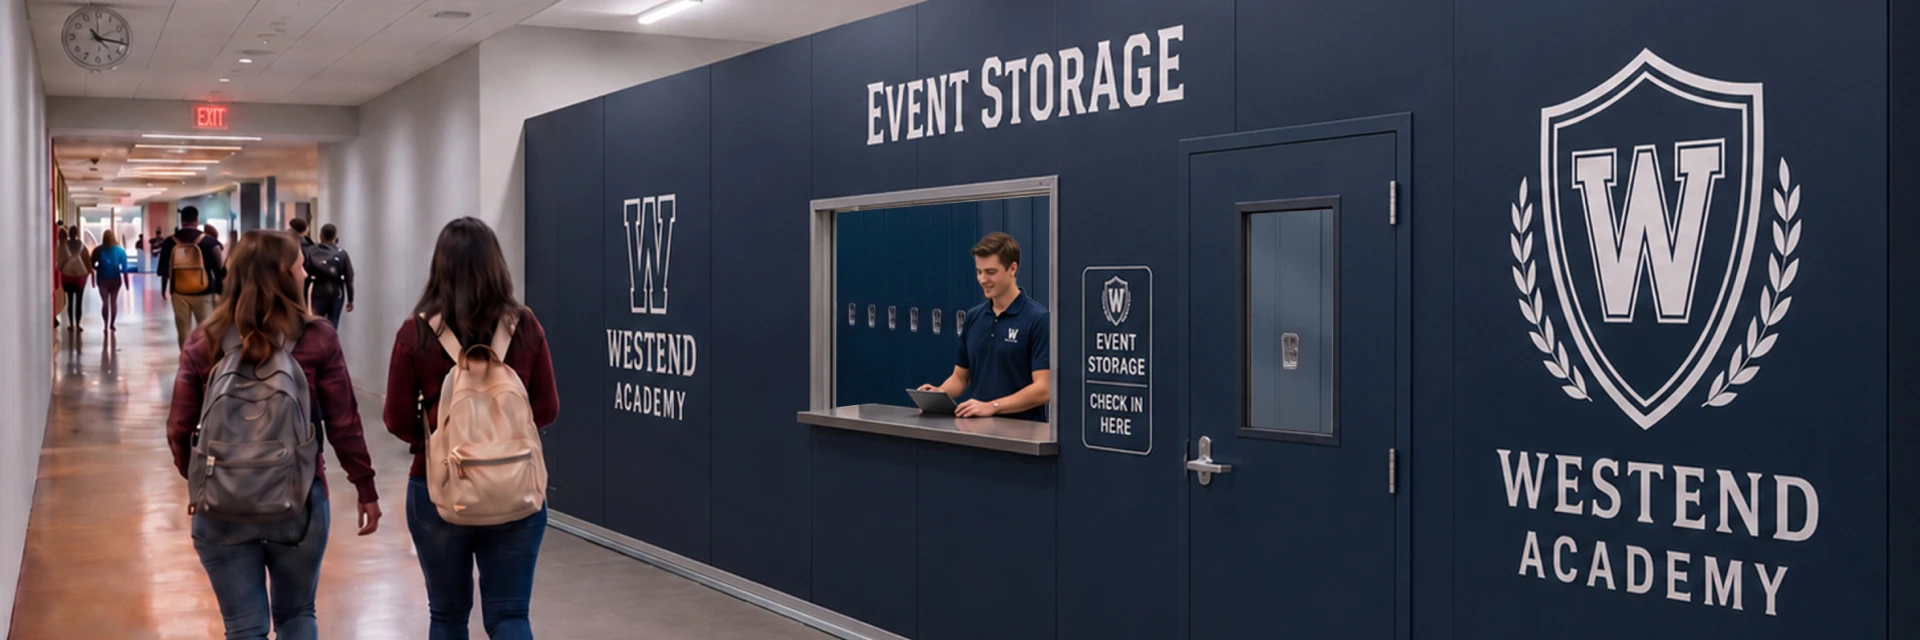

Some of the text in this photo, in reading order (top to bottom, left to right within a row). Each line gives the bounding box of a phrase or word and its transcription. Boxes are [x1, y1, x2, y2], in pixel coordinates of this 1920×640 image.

[866, 24, 1186, 146] EVENT STORAGE
[197, 107, 227, 126] EXIT
[1571, 137, 1726, 324] W
[623, 193, 676, 315] W
[1108, 288, 1125, 313] W
[1008, 327, 1019, 340] W
[1096, 332, 1137, 351] EVENT
[606, 329, 697, 377] WESTEND
[1088, 355, 1146, 376] STORAGE
[614, 382, 686, 421] ACADEMY
[1090, 393, 1143, 413] CHECK IN
[1100, 416, 1132, 436] HERE
[1496, 448, 1820, 543] WESTEND
[1518, 529, 1788, 616] ACADEMY
